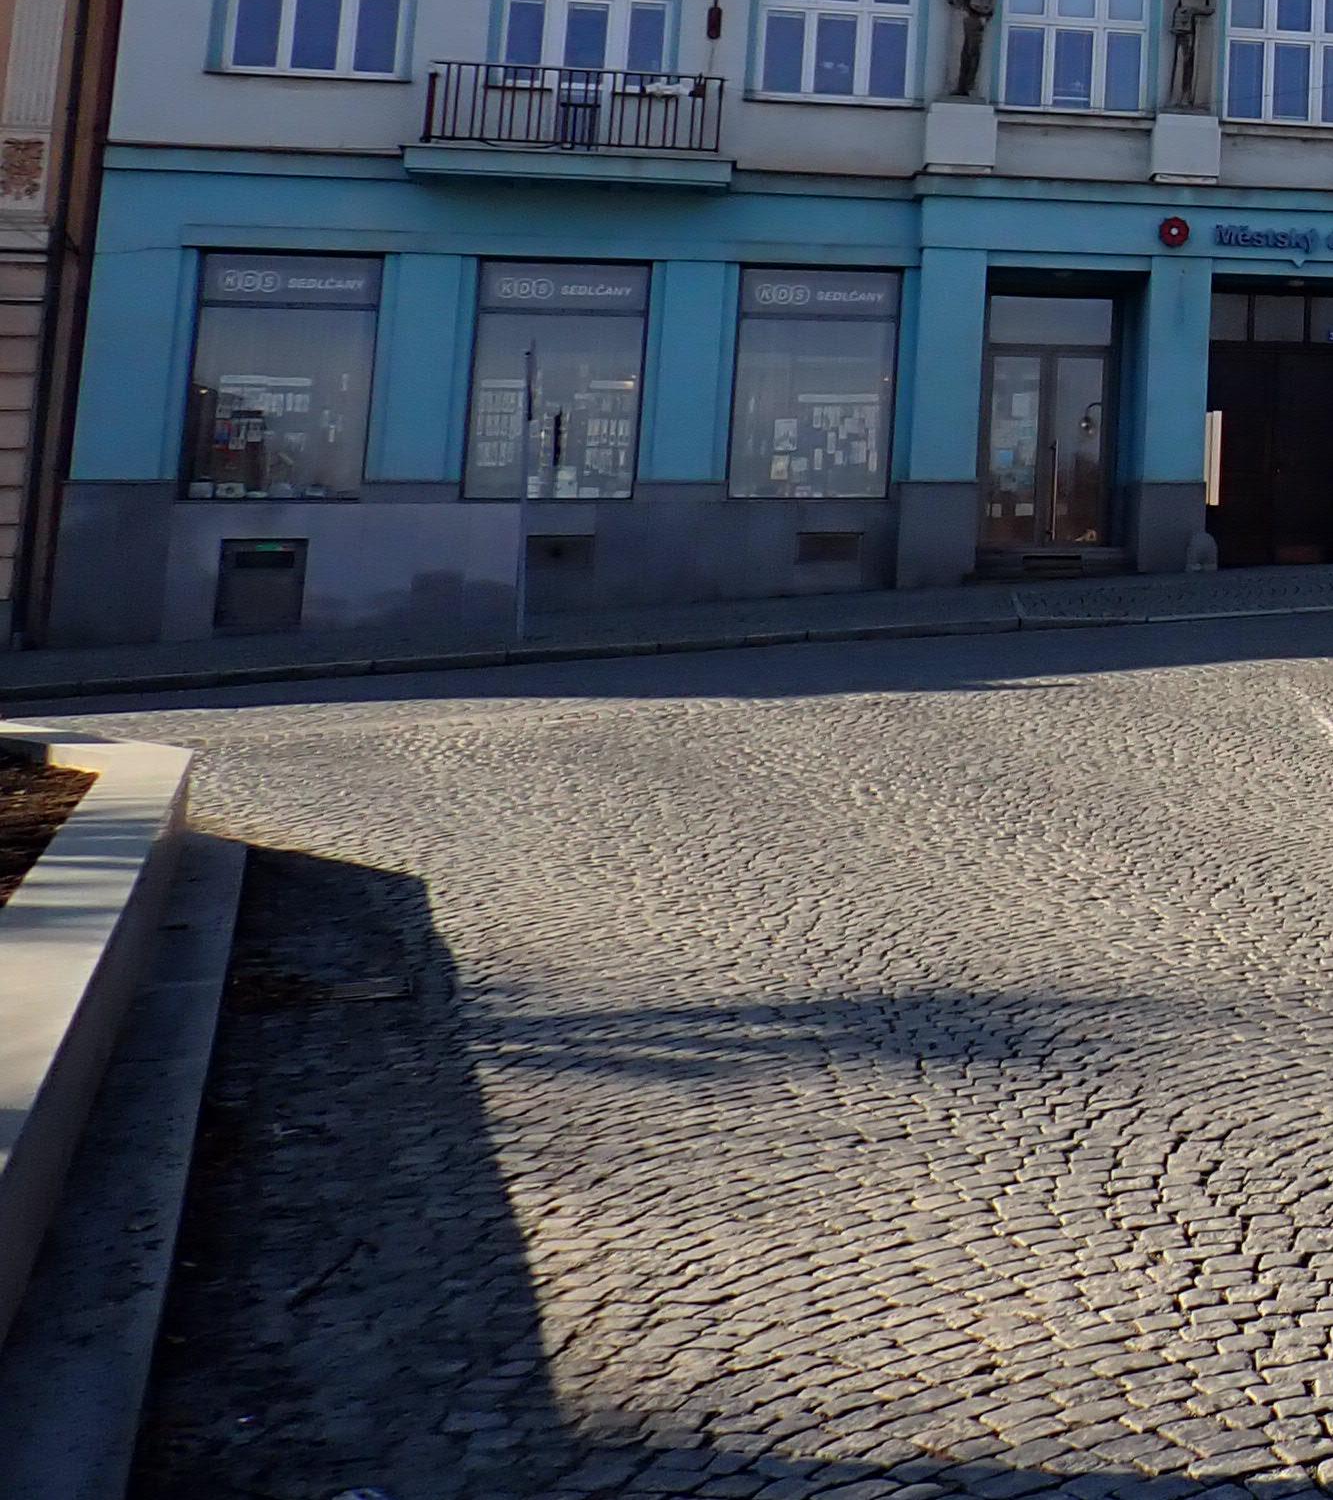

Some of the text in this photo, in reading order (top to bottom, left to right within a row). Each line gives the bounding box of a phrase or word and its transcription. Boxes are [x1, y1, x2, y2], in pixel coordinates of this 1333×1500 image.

[1214, 223, 1318, 255] Městský
[220, 271, 364, 291] KDS SEDLČANY
[499, 279, 632, 298] KDS SEDLČANY
[757, 285, 885, 304] KDS SEDLČANY
